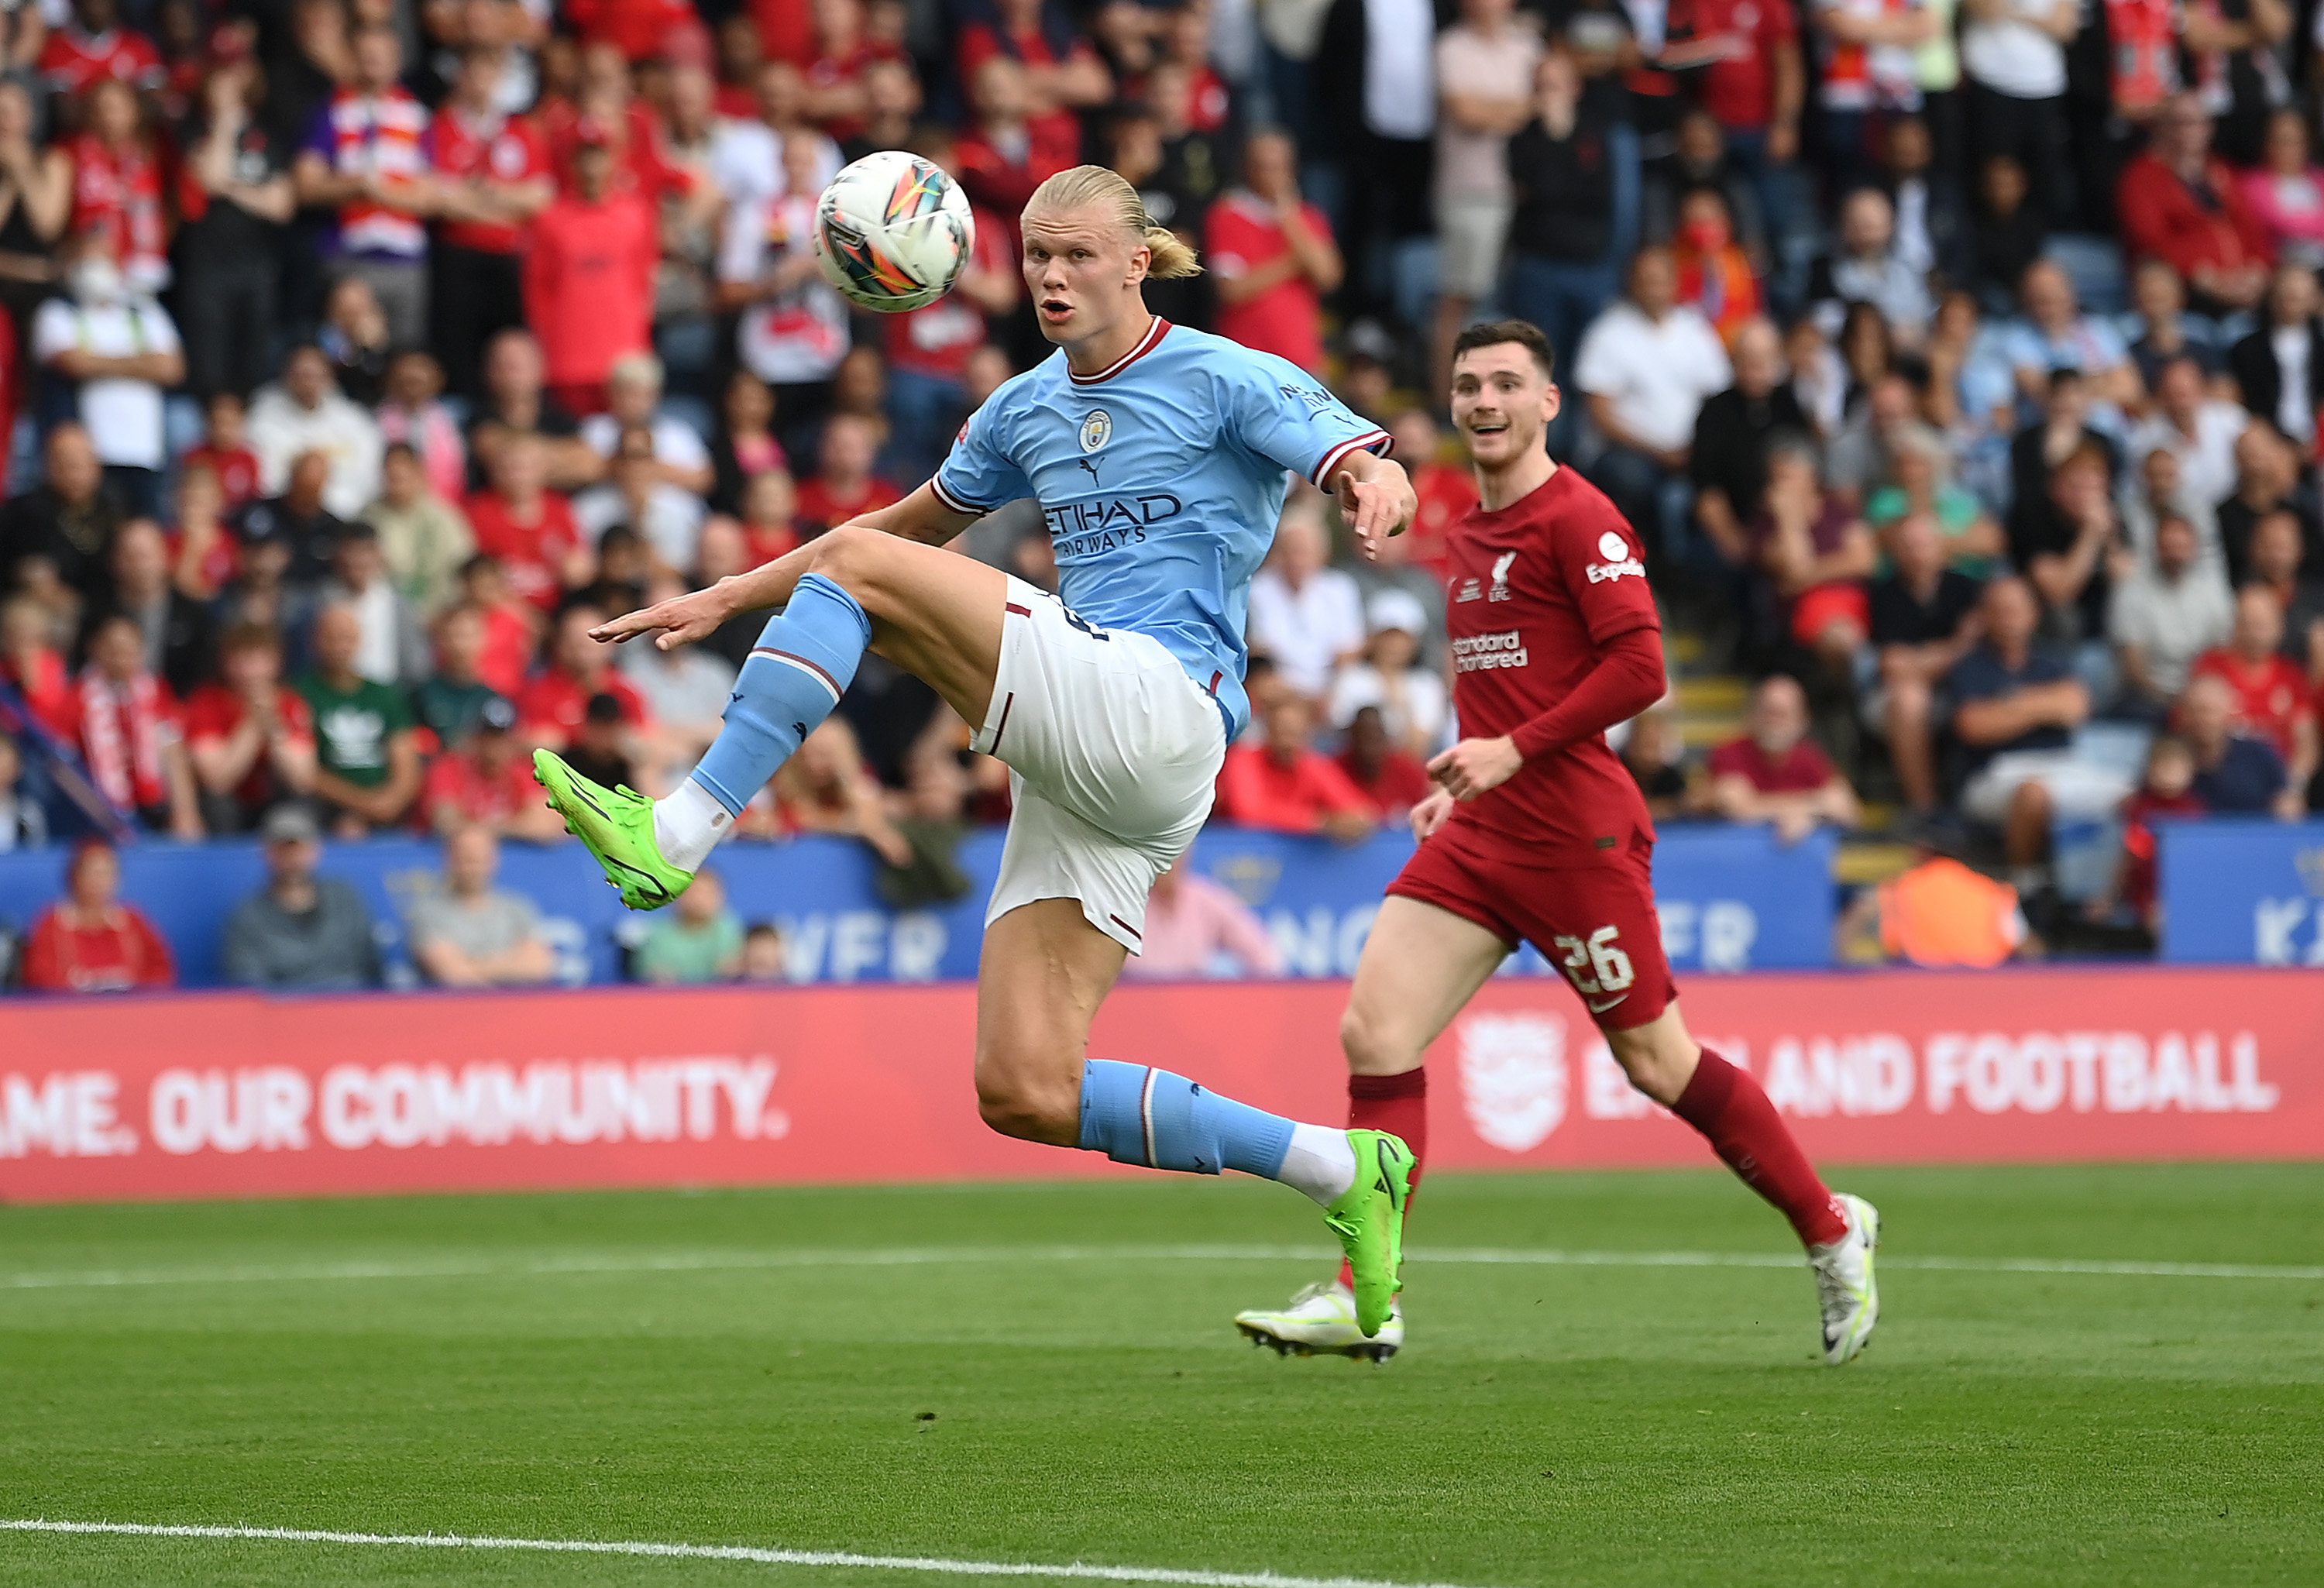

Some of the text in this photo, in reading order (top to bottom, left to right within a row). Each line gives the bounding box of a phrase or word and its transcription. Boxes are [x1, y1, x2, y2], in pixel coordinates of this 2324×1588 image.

[1045, 494, 1182, 535] ETIHAD
[1553, 924, 1635, 994] 26
[0, 1054, 791, 1160] ME. OUR COMMUNITY.
[1581, 1028, 2281, 1120] EAND FOOTBALL
